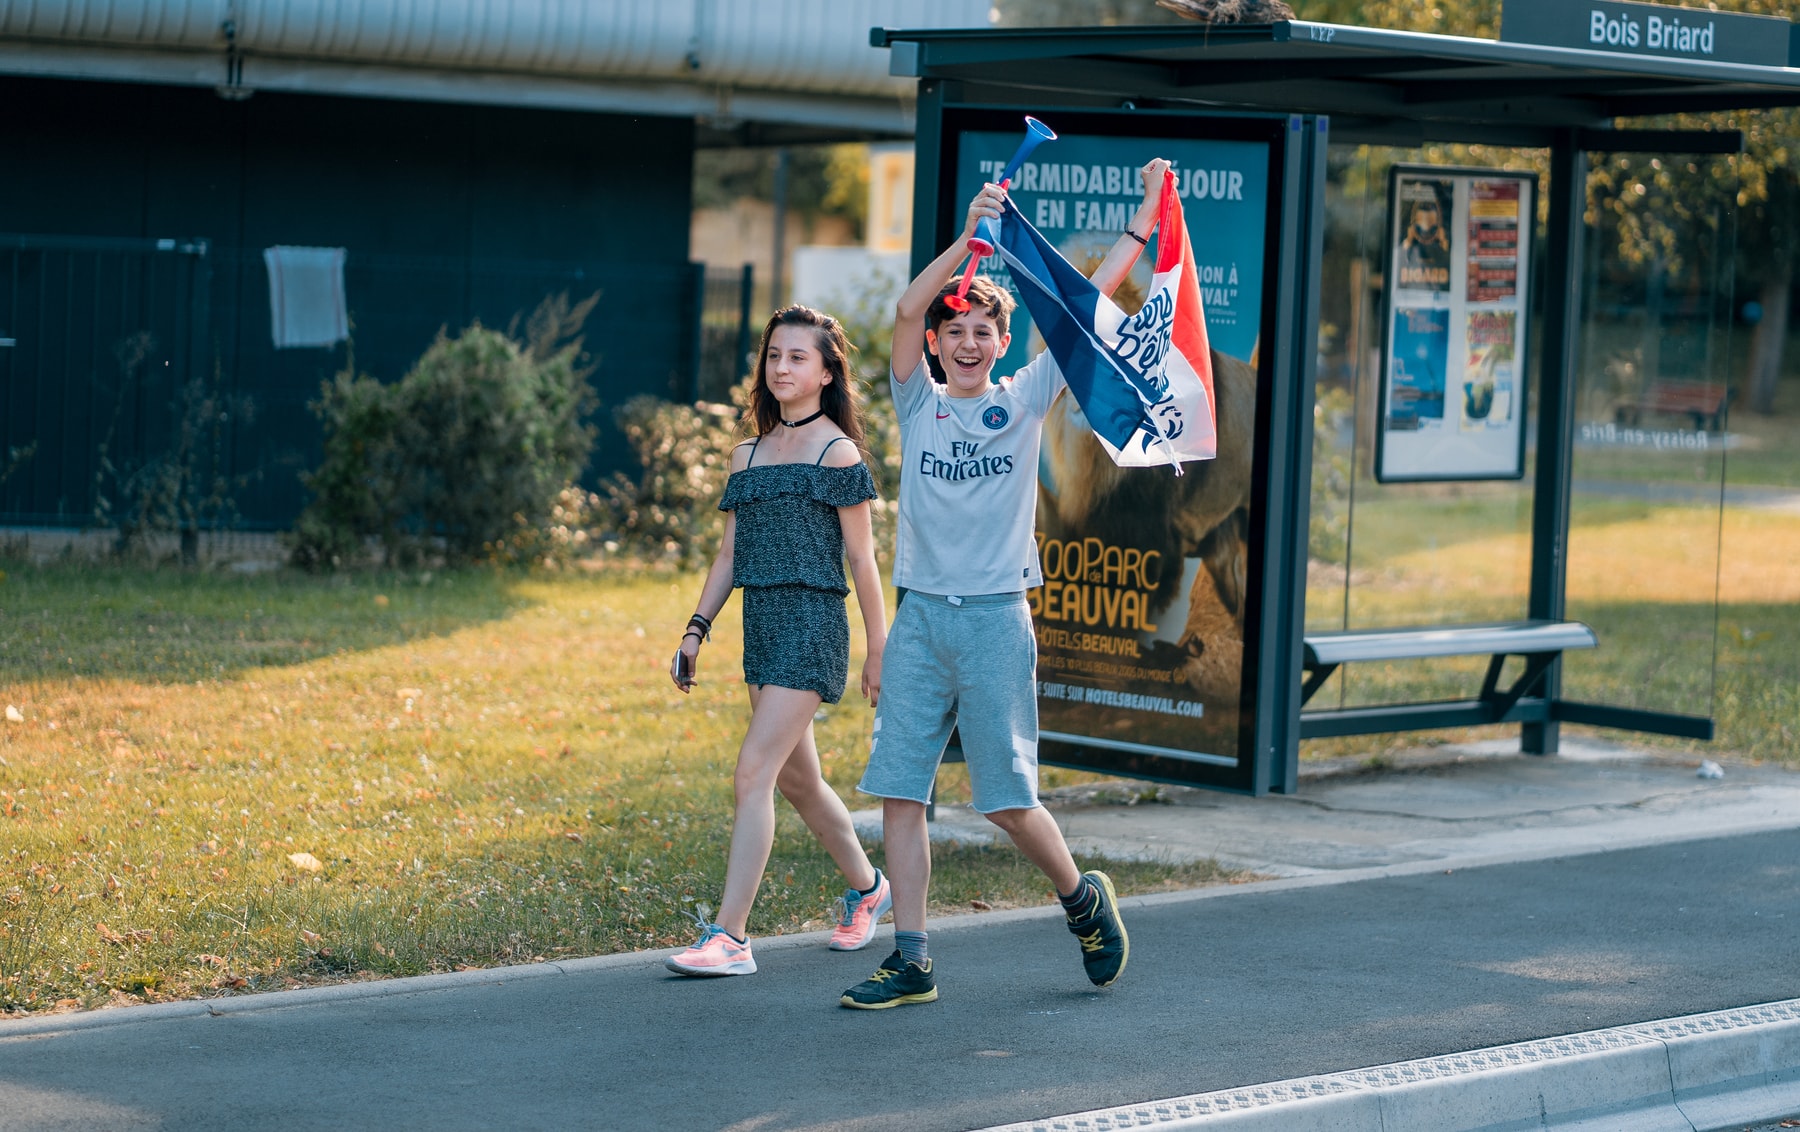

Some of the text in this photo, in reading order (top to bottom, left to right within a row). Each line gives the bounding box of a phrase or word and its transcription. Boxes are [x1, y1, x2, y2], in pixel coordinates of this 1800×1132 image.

[1590, 10, 1714, 54] Bois Briard
[1036, 199, 1065, 229] EN
[1228, 262, 1239, 285] À
[951, 441, 979, 457] Fly
[920, 451, 1013, 481] Emirates
[1043, 682, 1067, 699] SUITE
[1067, 685, 1084, 702] SUR
[1085, 687, 1204, 718] HOTELSBEAUVAL.COM
